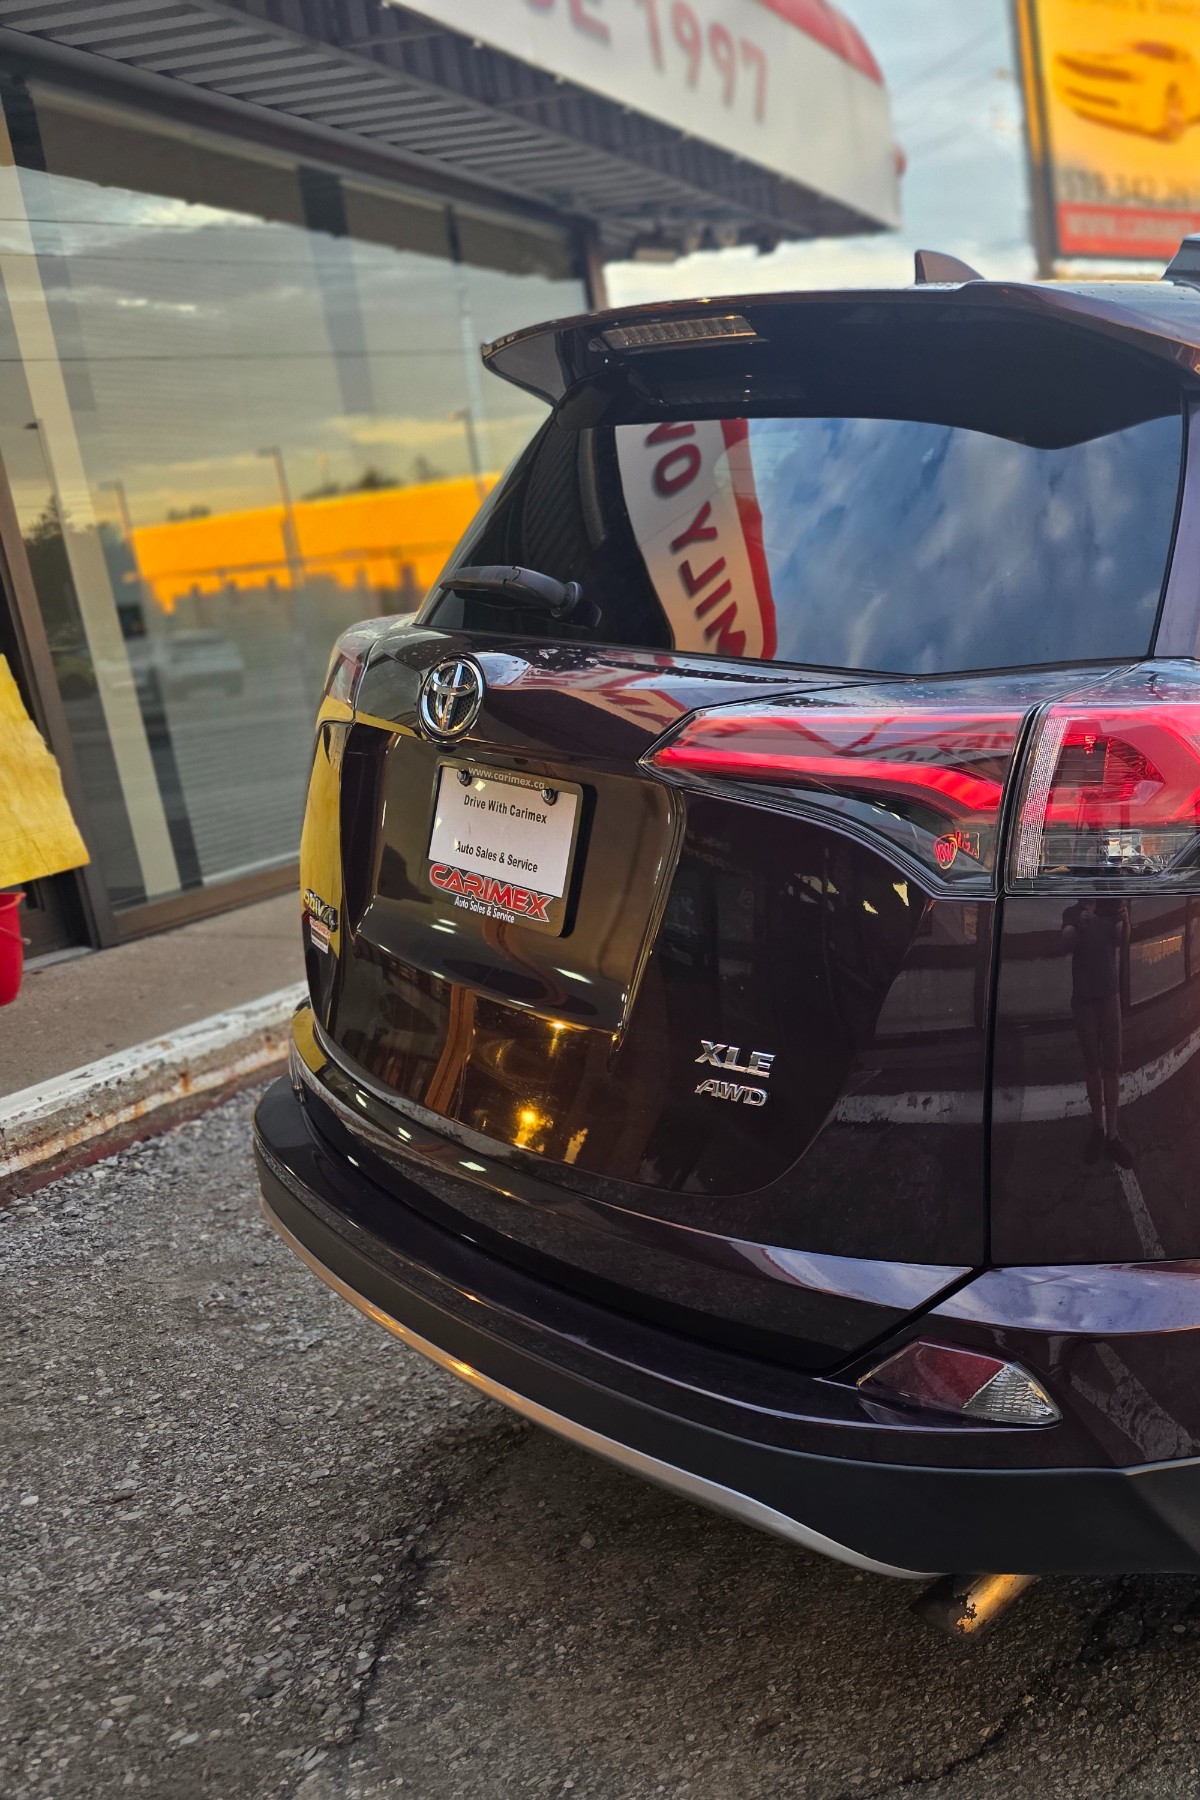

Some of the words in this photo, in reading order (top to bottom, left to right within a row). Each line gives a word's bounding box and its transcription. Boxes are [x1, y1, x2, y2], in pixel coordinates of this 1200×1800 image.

[634, 0, 768, 125] 1997
[468, 766, 546, 789] www.carimex.ca
[464, 794, 486, 810] Drive
[488, 800, 508, 815] With
[510, 804, 548, 825] Carimex
[455, 841, 474, 856] Auto
[476, 845, 497, 862] Sales
[499, 852, 506, 864] &
[507, 854, 539, 873] Service
[429, 863, 553, 922] CARIMEX
[454, 896, 469, 909] Auto
[470, 900, 486, 915] Sales
[492, 905, 515, 923] Service
[694, 1040, 776, 1078] XLE
[694, 1079, 769, 1106] AWD
